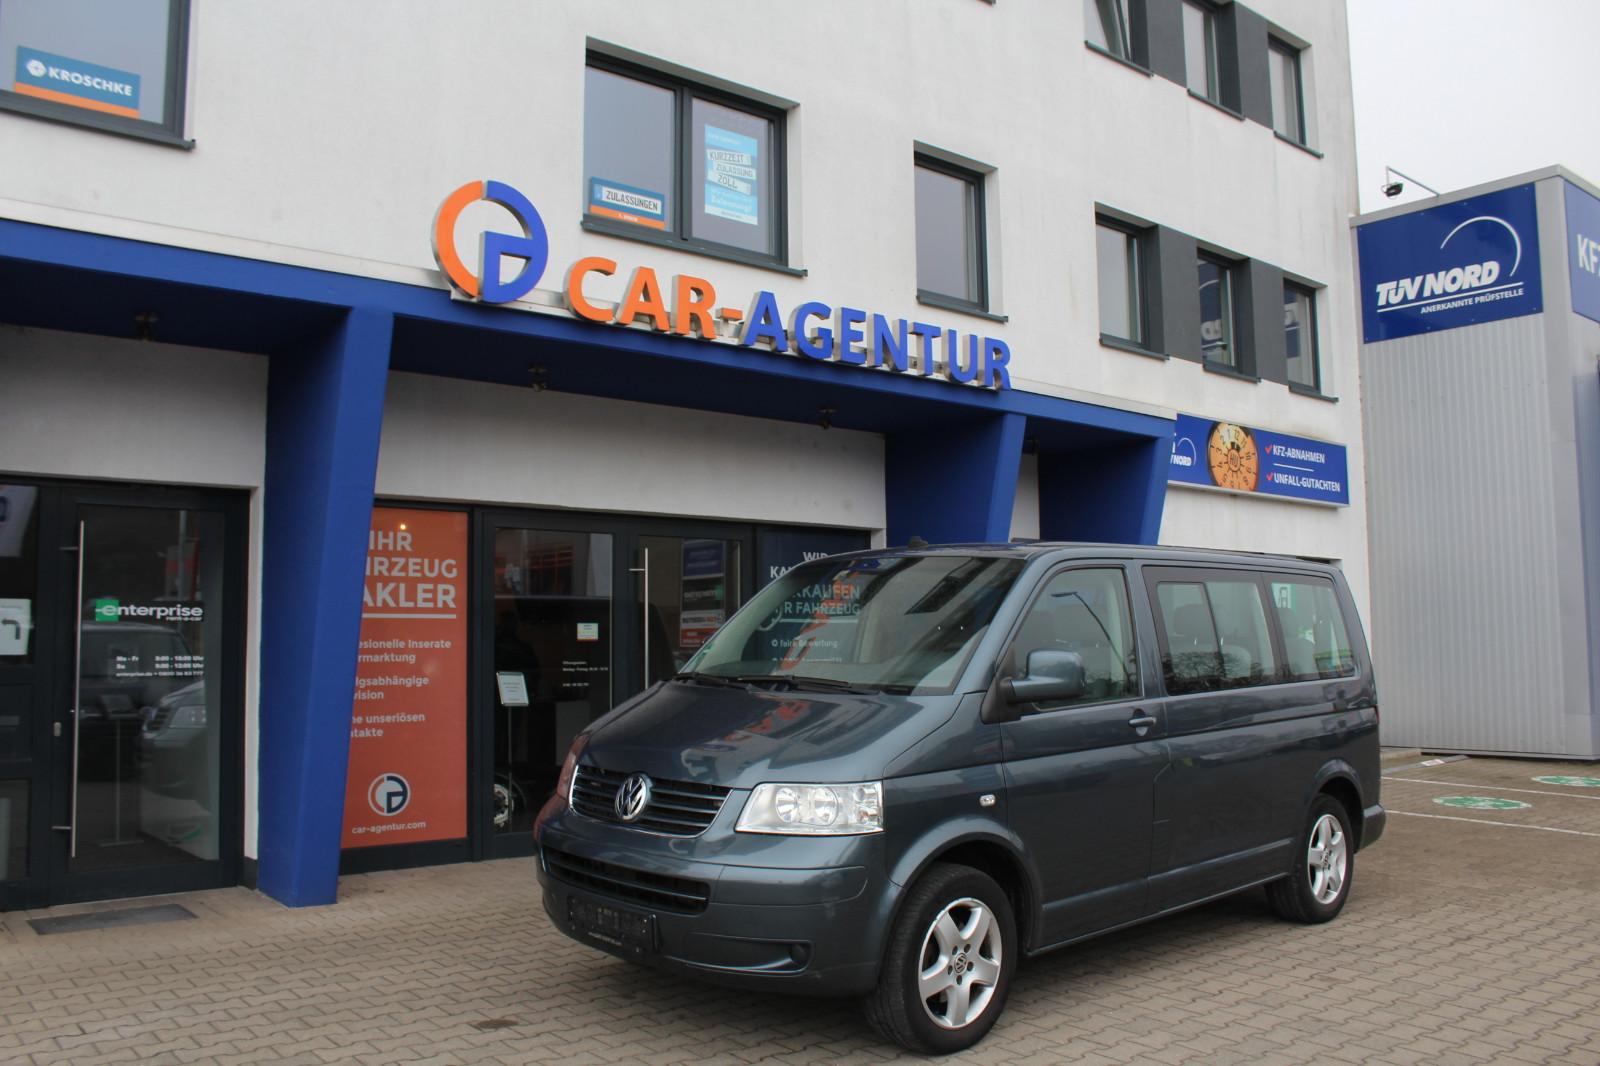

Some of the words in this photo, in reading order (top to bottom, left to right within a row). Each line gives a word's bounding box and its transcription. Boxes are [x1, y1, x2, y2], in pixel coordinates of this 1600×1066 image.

[49, 66, 133, 97] KROSCHKE
[709, 151, 744, 164] KURZZEIT
[718, 174, 738, 189] ZOLL
[605, 190, 659, 211] ZULASSUNGEN
[1576, 233, 1600, 276] KF
[1423, 260, 1500, 297] NORD
[1420, 298, 1474, 314] ANERKANNTE
[1474, 287, 1525, 305] PRÜFSTELLE
[564, 256, 1012, 391] CAR-AGENTUR
[1273, 444, 1325, 464] KFZ-ABNAHMEN
[1274, 472, 1341, 492] UNFALL-GUTACHTEN
[369, 530, 413, 551] IHR
[793, 584, 860, 599] KAUFEN
[97, 604, 203, 619] enterprise
[796, 602, 861, 615] FAHRZEUG
[408, 639, 452, 649] Inserate
[352, 821, 426, 834] car-agentur.com
